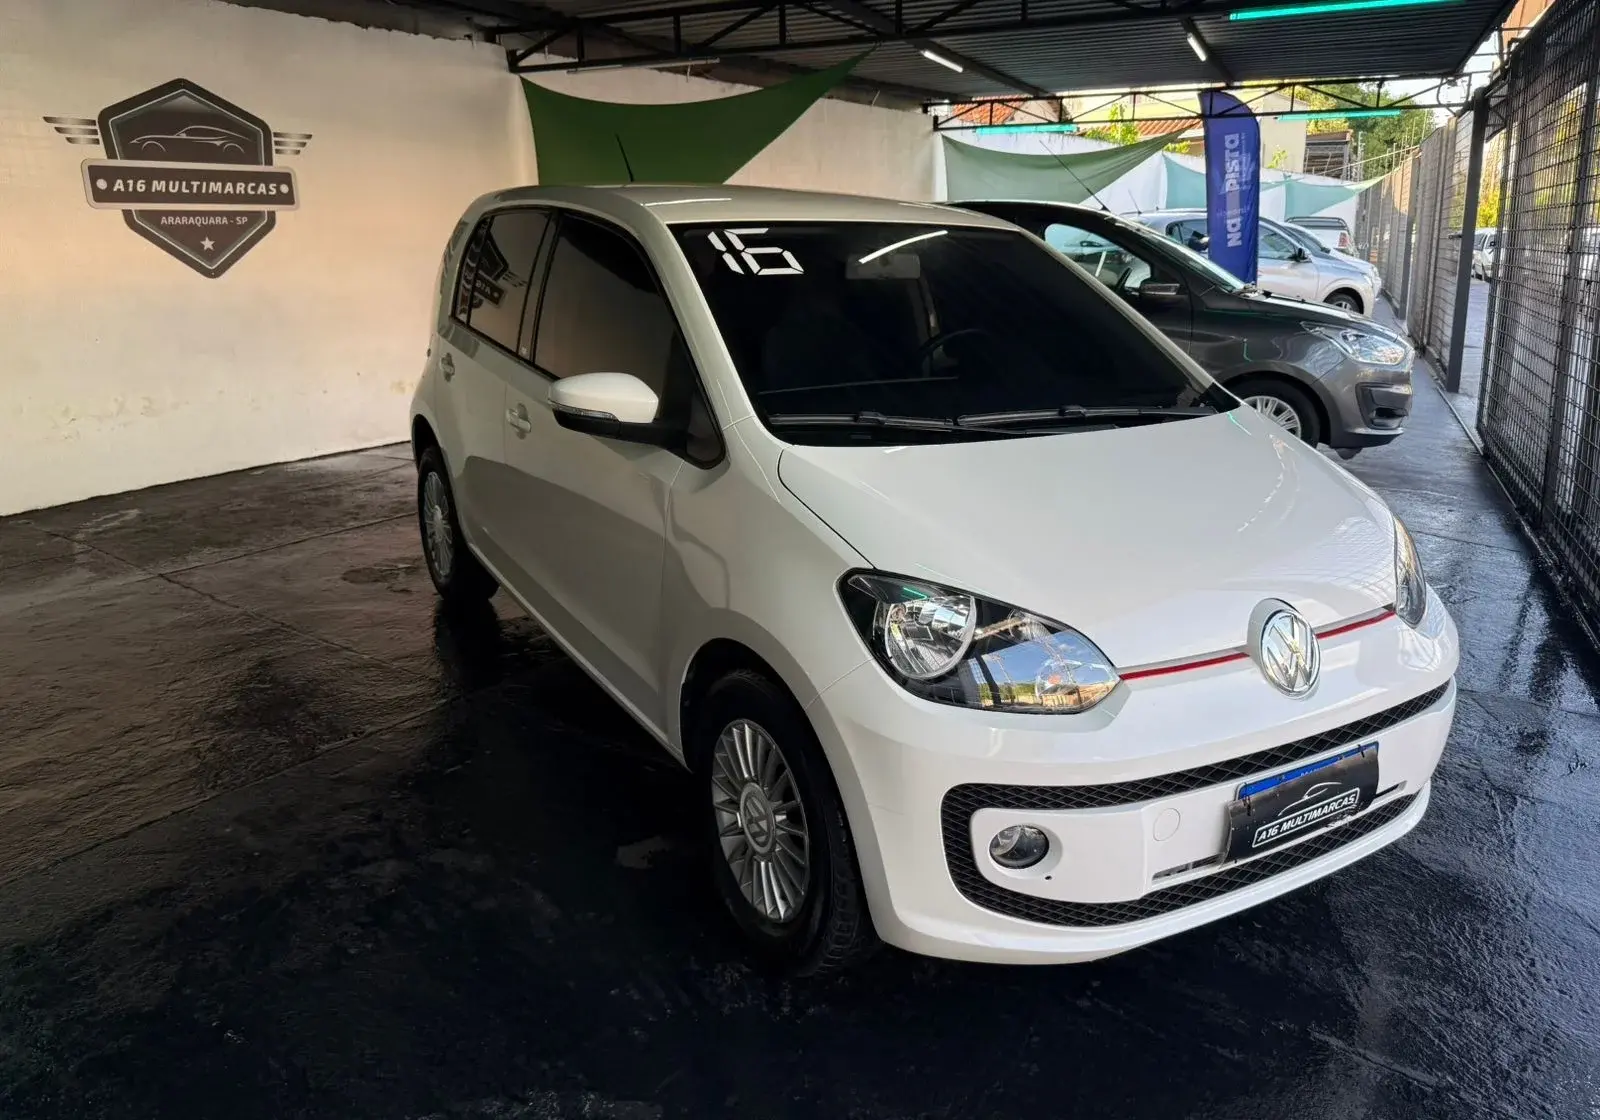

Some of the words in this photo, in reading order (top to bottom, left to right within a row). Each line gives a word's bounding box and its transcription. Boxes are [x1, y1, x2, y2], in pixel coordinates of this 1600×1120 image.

[113, 179, 147, 193] A16
[151, 180, 278, 195] MULTIMARCAS
[160, 216, 229, 227] ARARAQUARA
[236, 216, 248, 225] SP
[707, 227, 805, 275] 16
[1257, 825, 1280, 842] A16
[1280, 794, 1356, 832] MULTIMARCAS
